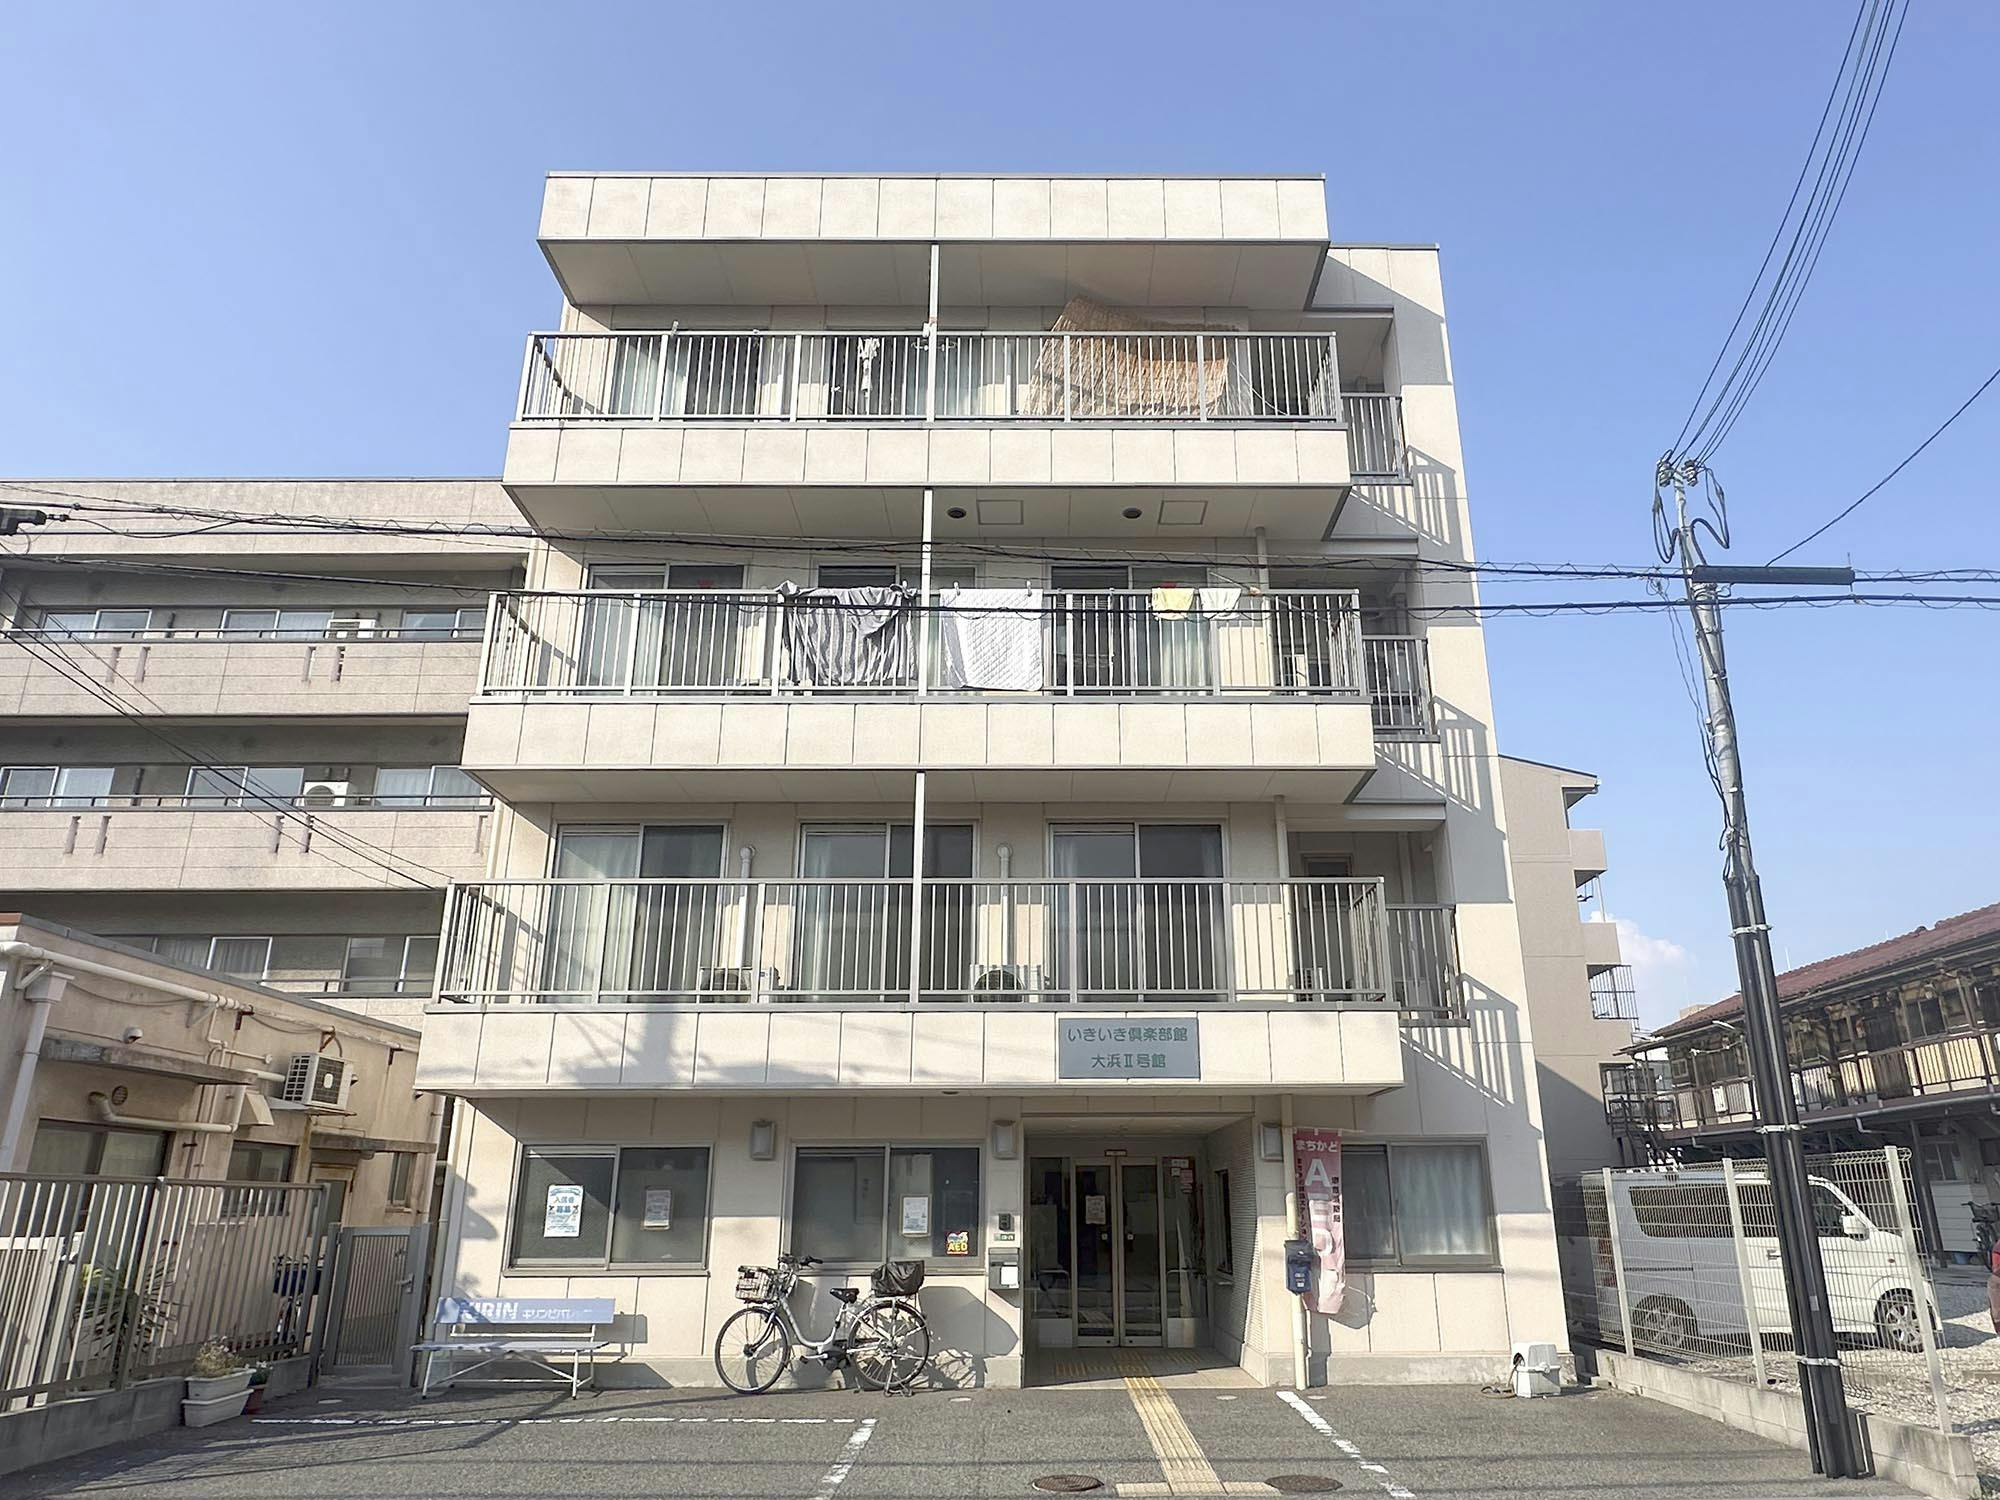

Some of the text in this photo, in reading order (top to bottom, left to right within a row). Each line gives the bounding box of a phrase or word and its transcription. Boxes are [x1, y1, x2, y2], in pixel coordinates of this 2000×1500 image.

[1067, 1027, 1188, 1042] いきいき倶楽部館
[1295, 1140, 1338, 1153] まちかど
[947, 1242, 968, 1252] AED
